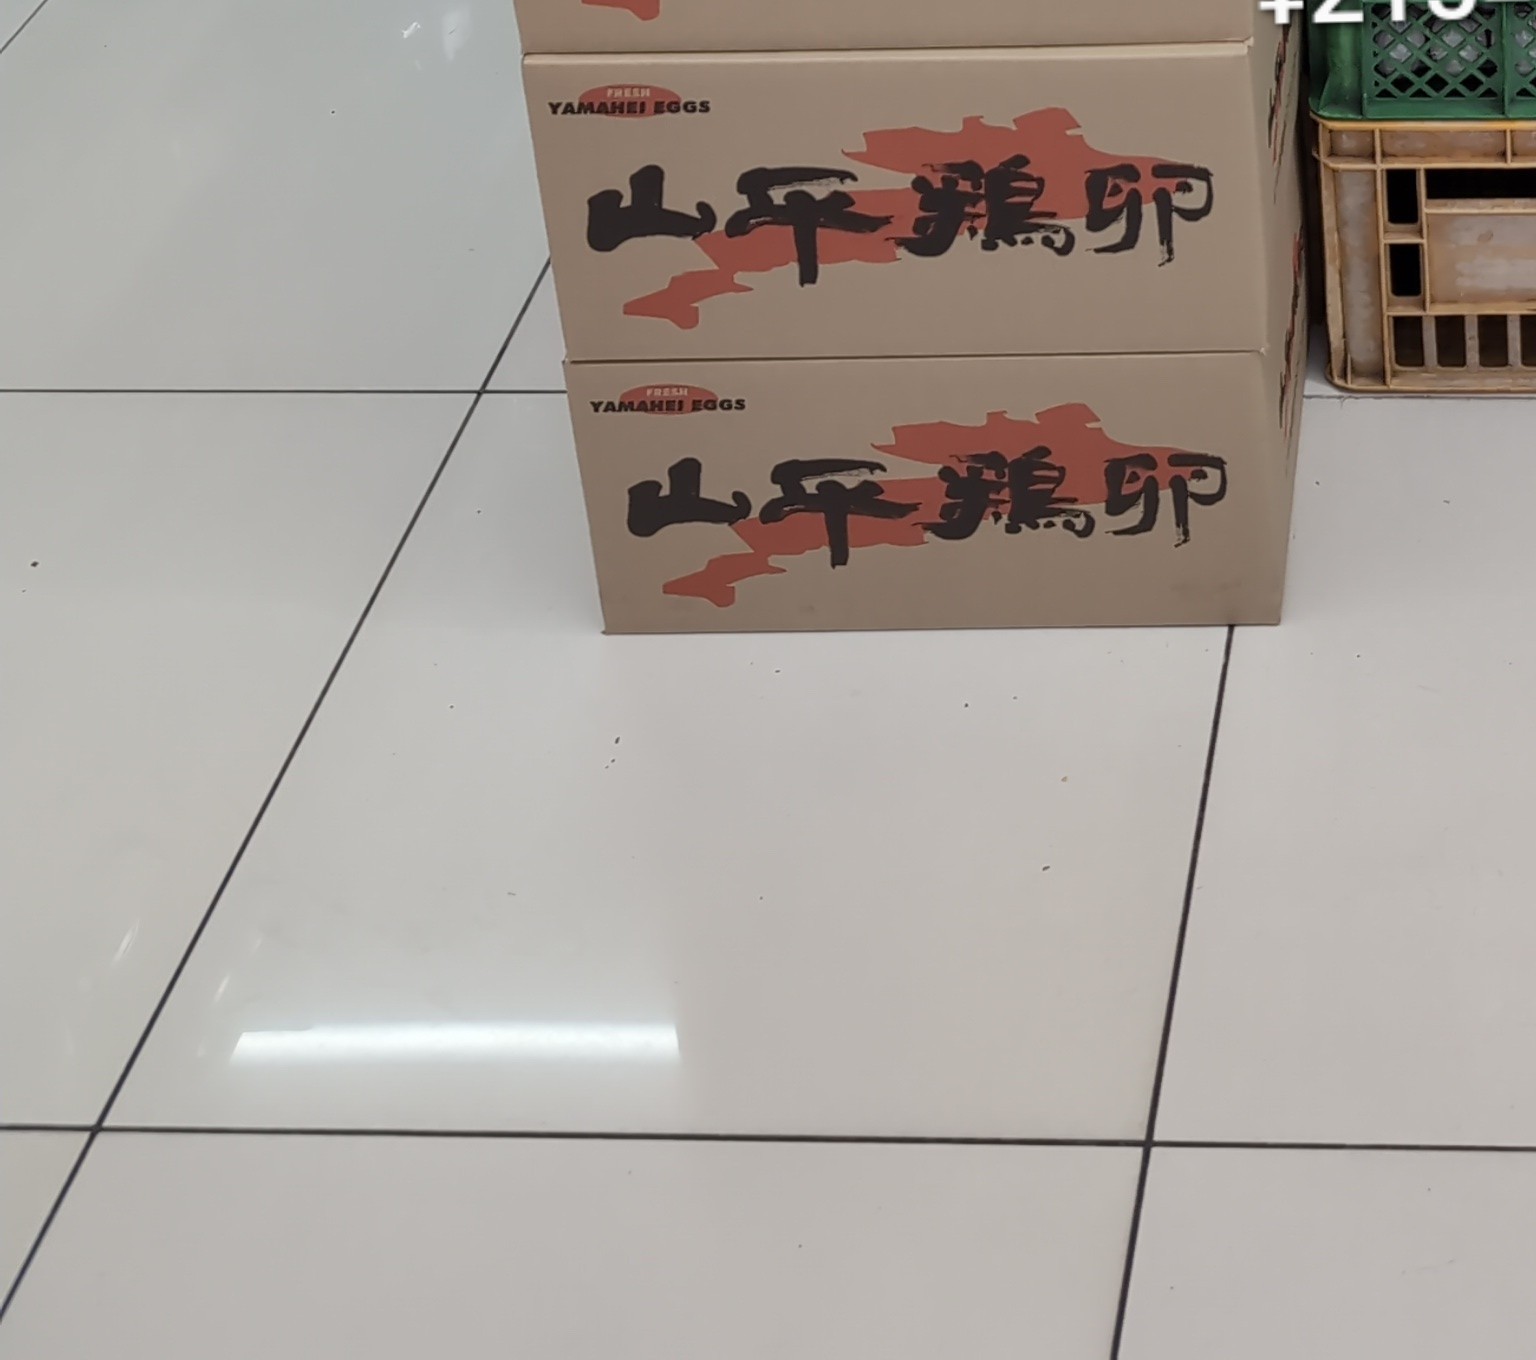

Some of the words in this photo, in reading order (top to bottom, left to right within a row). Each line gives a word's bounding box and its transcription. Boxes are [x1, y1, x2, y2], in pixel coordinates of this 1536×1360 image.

[606, 86, 652, 99] FRESH
[547, 100, 648, 116] YAMAHEI
[653, 98, 712, 116] EGGS
[645, 385, 689, 399] FRESH
[589, 398, 686, 415] YAMAHEI
[691, 396, 747, 413] EGGS
